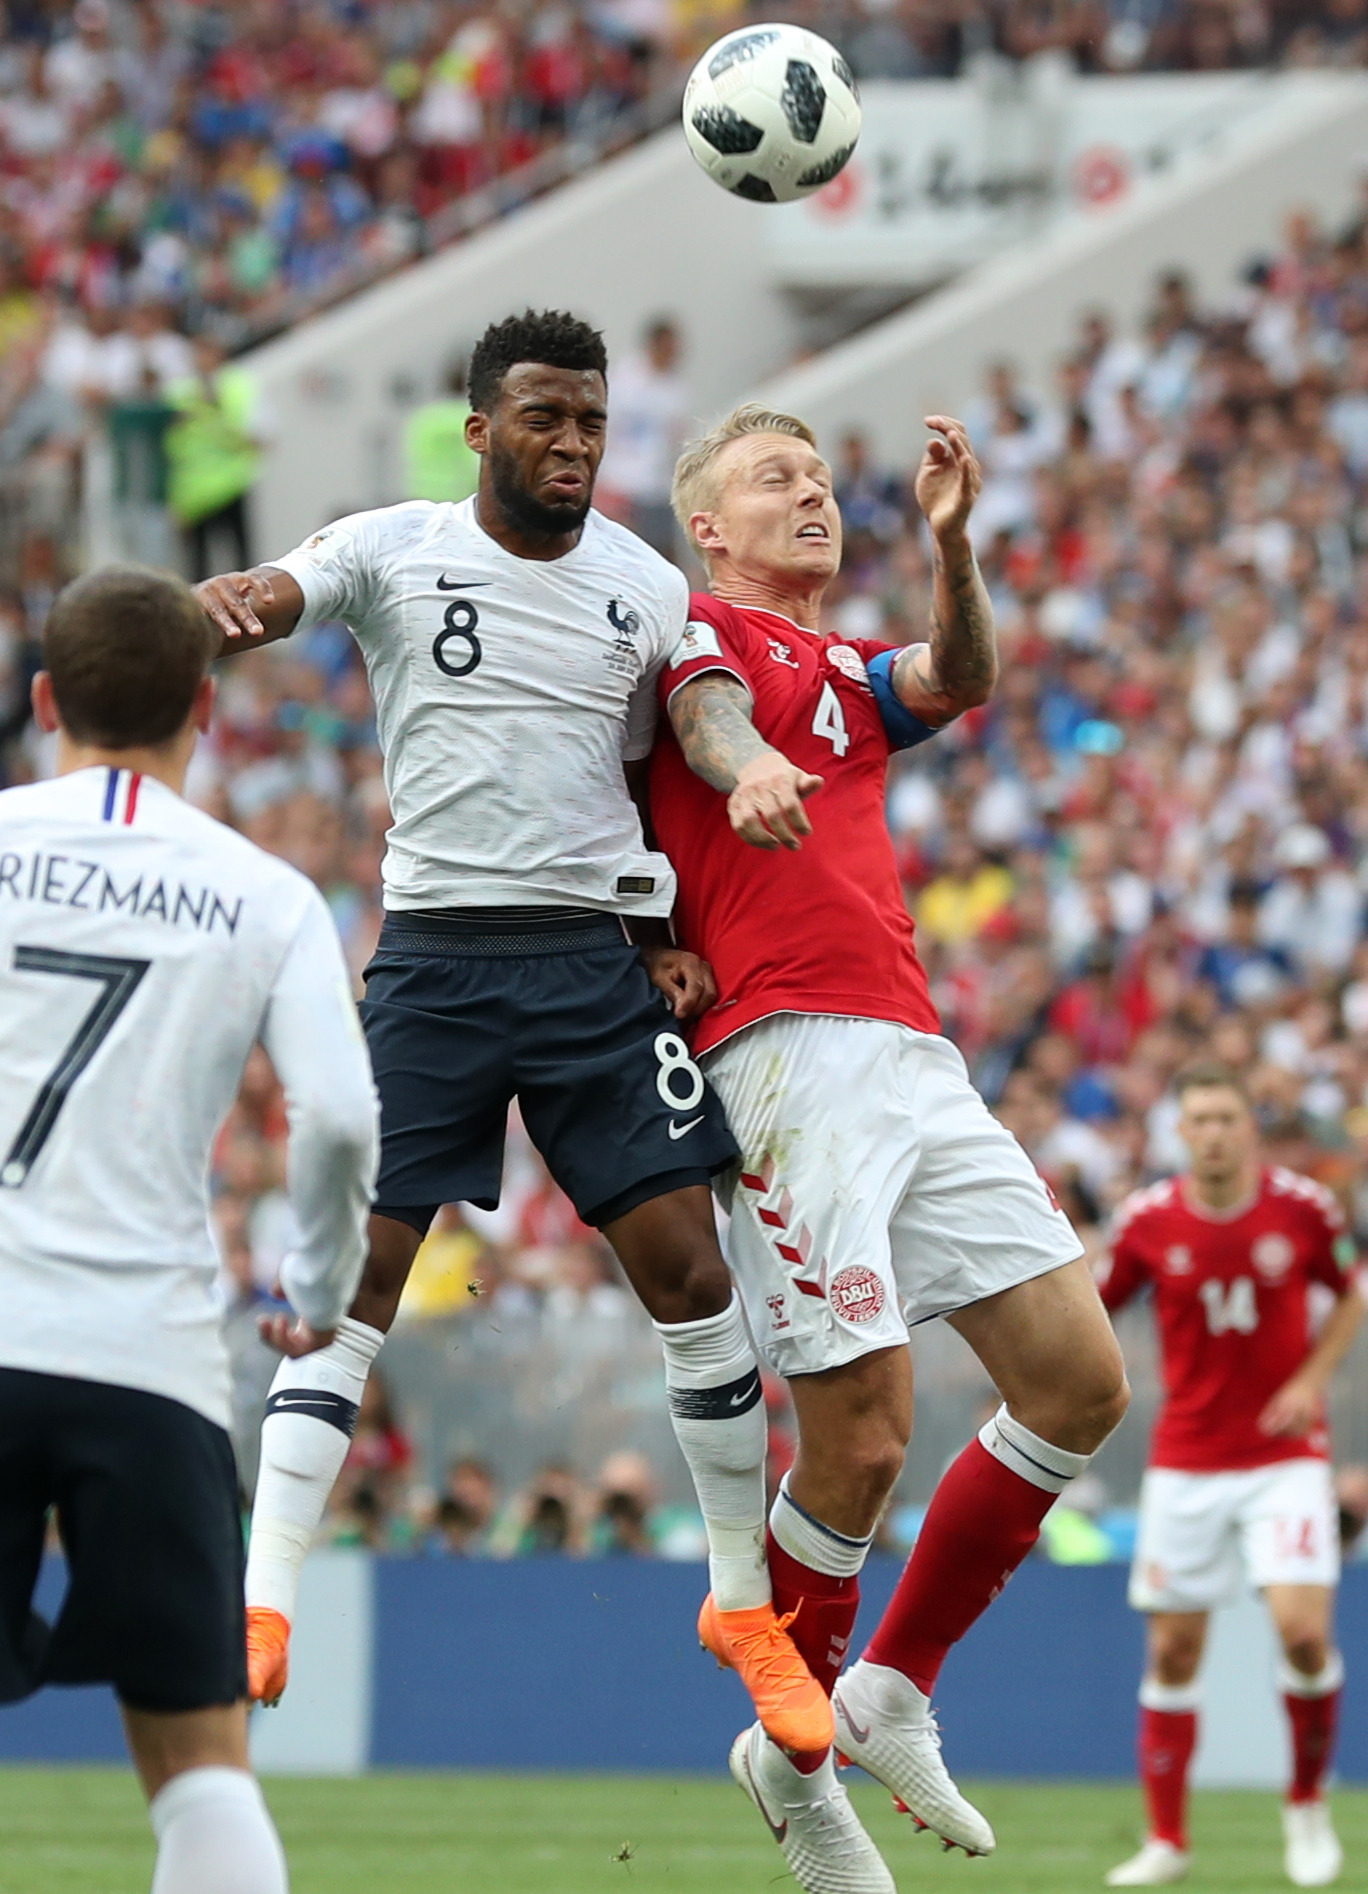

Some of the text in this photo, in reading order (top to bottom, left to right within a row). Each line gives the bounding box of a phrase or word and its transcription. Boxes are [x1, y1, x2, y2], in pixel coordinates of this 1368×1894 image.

[433, 600, 482, 677] 8
[812, 680, 850, 757] 4
[0, 853, 243, 938] RIEZMANN
[0, 944, 153, 1188] 7
[654, 1031, 705, 1111] 8
[840, 1281, 876, 1306] DBU
[1200, 1276, 1259, 1335] 14
